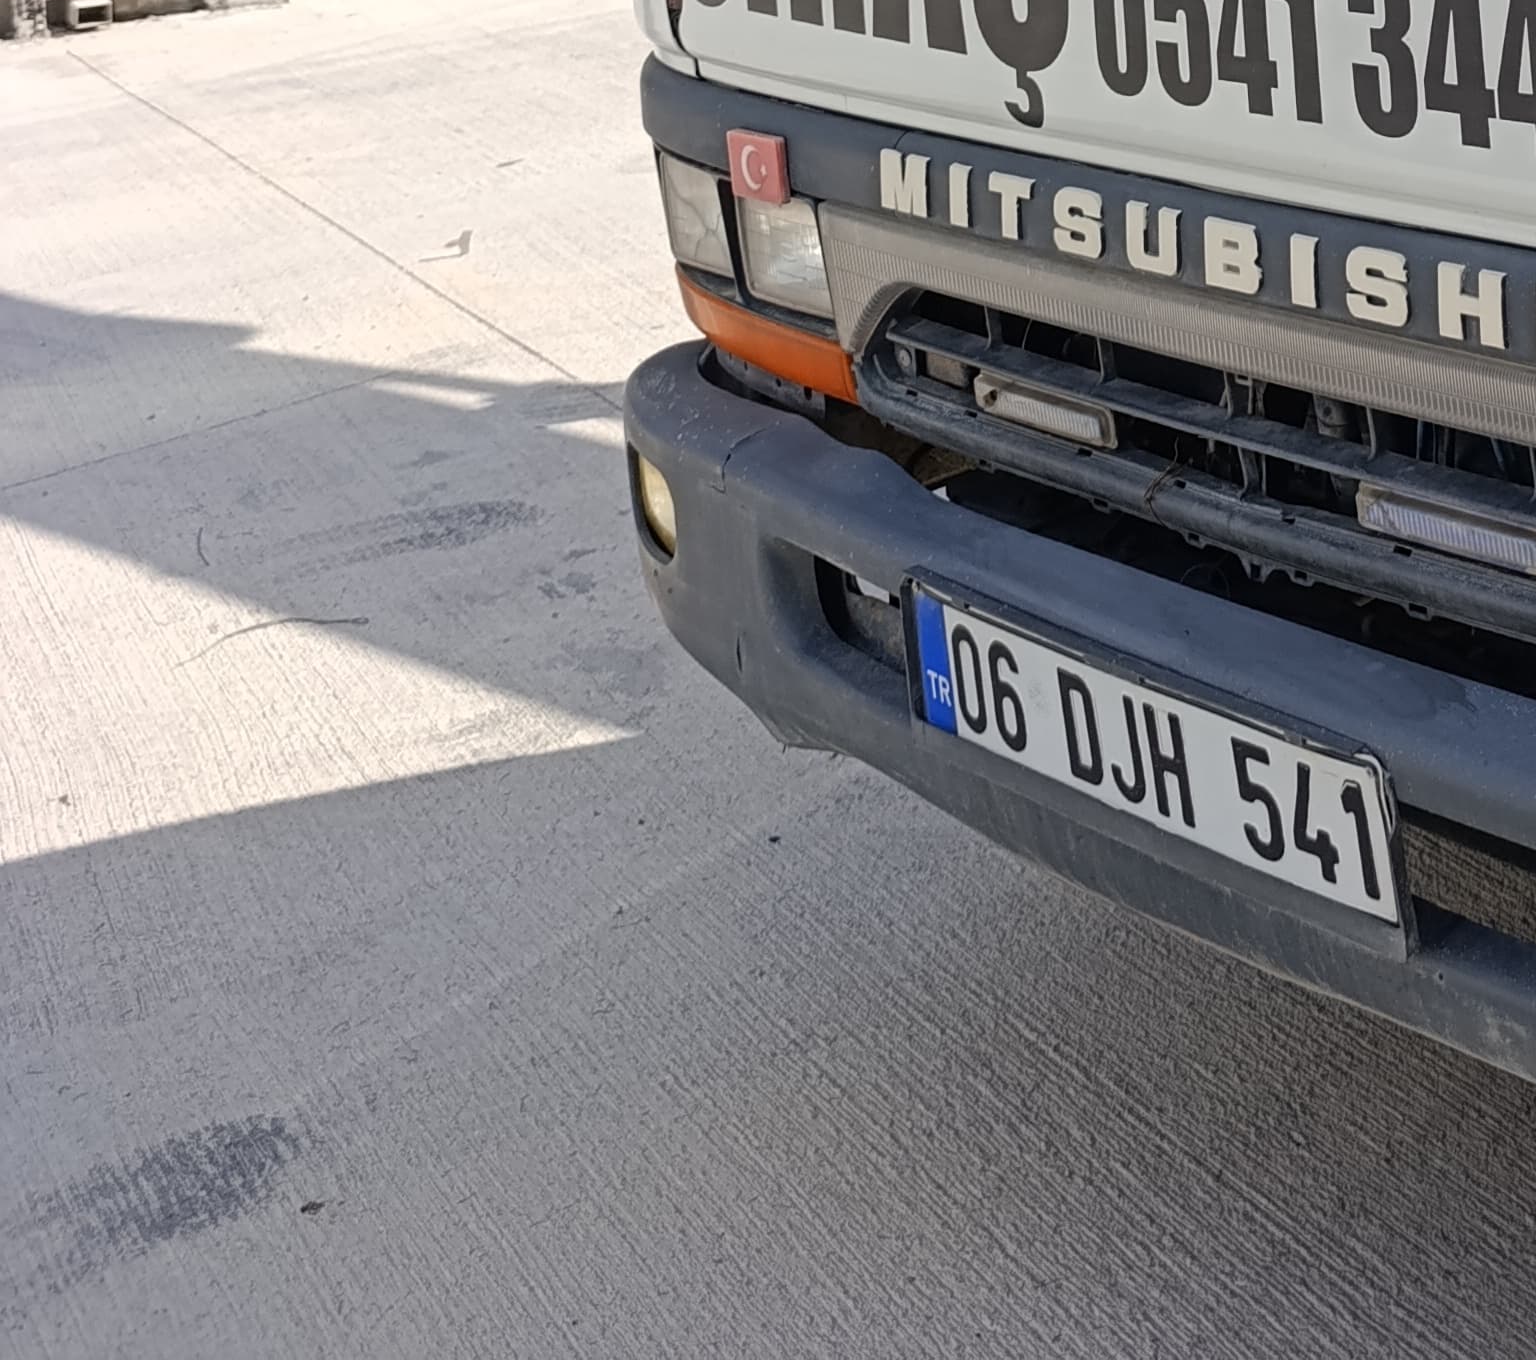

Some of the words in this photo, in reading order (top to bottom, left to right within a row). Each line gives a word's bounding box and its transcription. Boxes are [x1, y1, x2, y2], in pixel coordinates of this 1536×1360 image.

[927, 669, 952, 707] TR
[951, 623, 1028, 752] 06
[1057, 667, 1196, 828] DJH
[1231, 736, 1381, 902] 541
